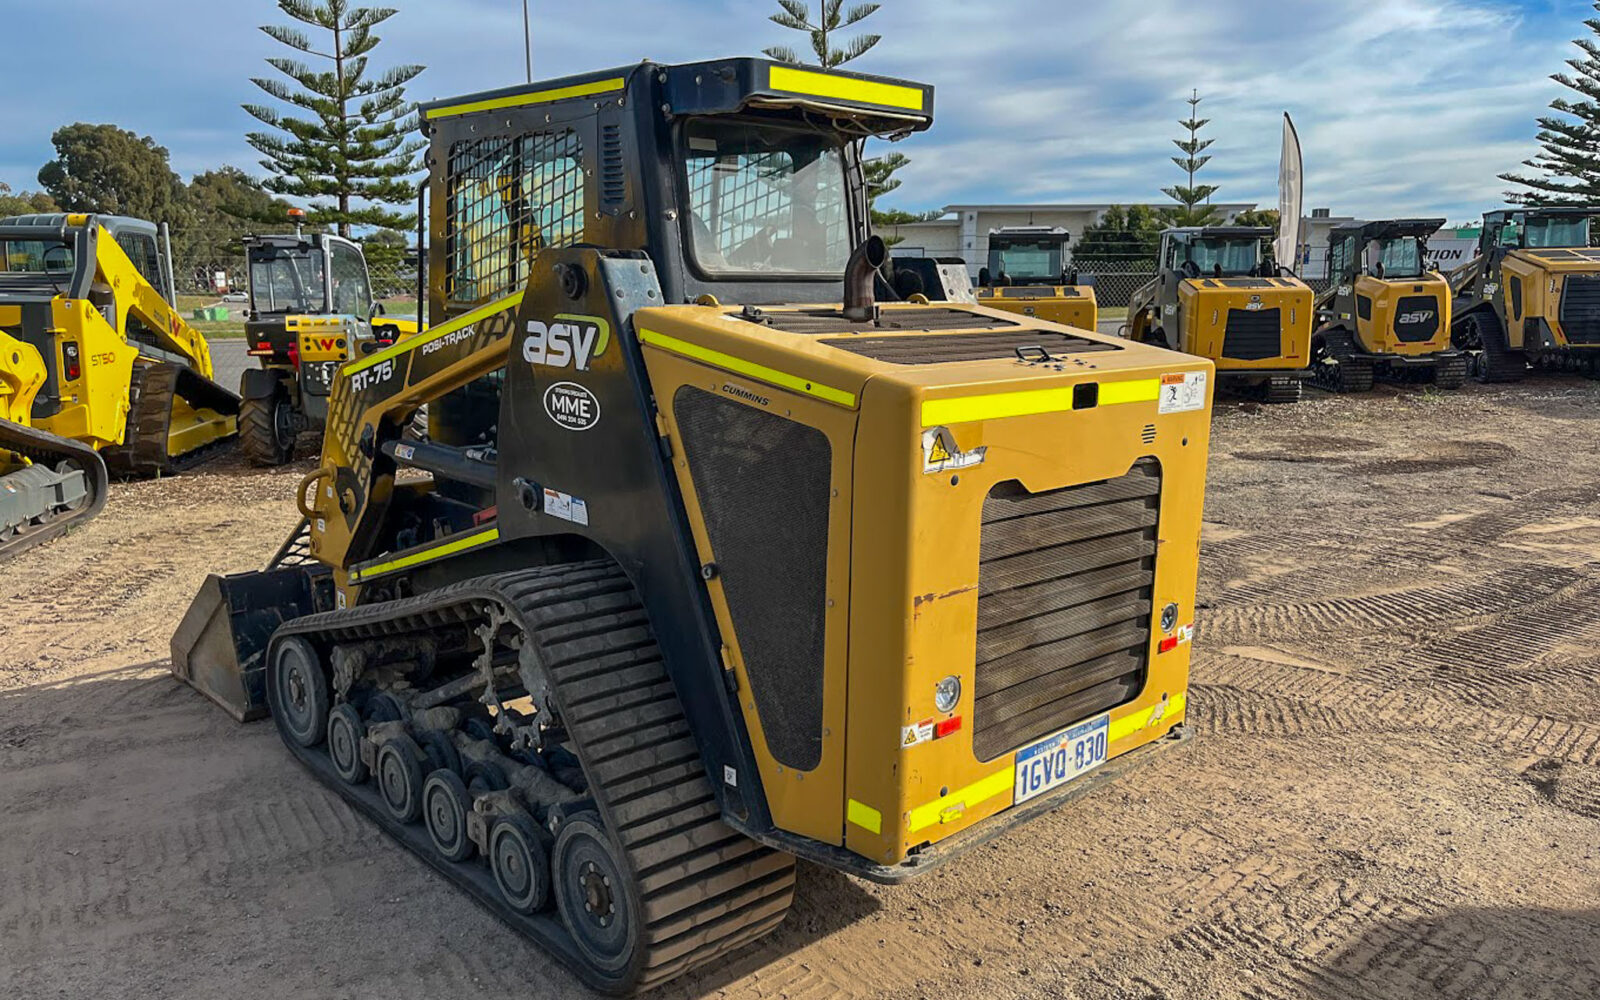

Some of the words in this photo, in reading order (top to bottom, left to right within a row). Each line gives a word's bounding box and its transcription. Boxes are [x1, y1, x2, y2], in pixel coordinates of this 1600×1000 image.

[422, 324, 475, 356] POSI-TRACK
[351, 360, 392, 393] RT-75
[552, 393, 591, 418] MME
[722, 384, 769, 406] CUMMINS
